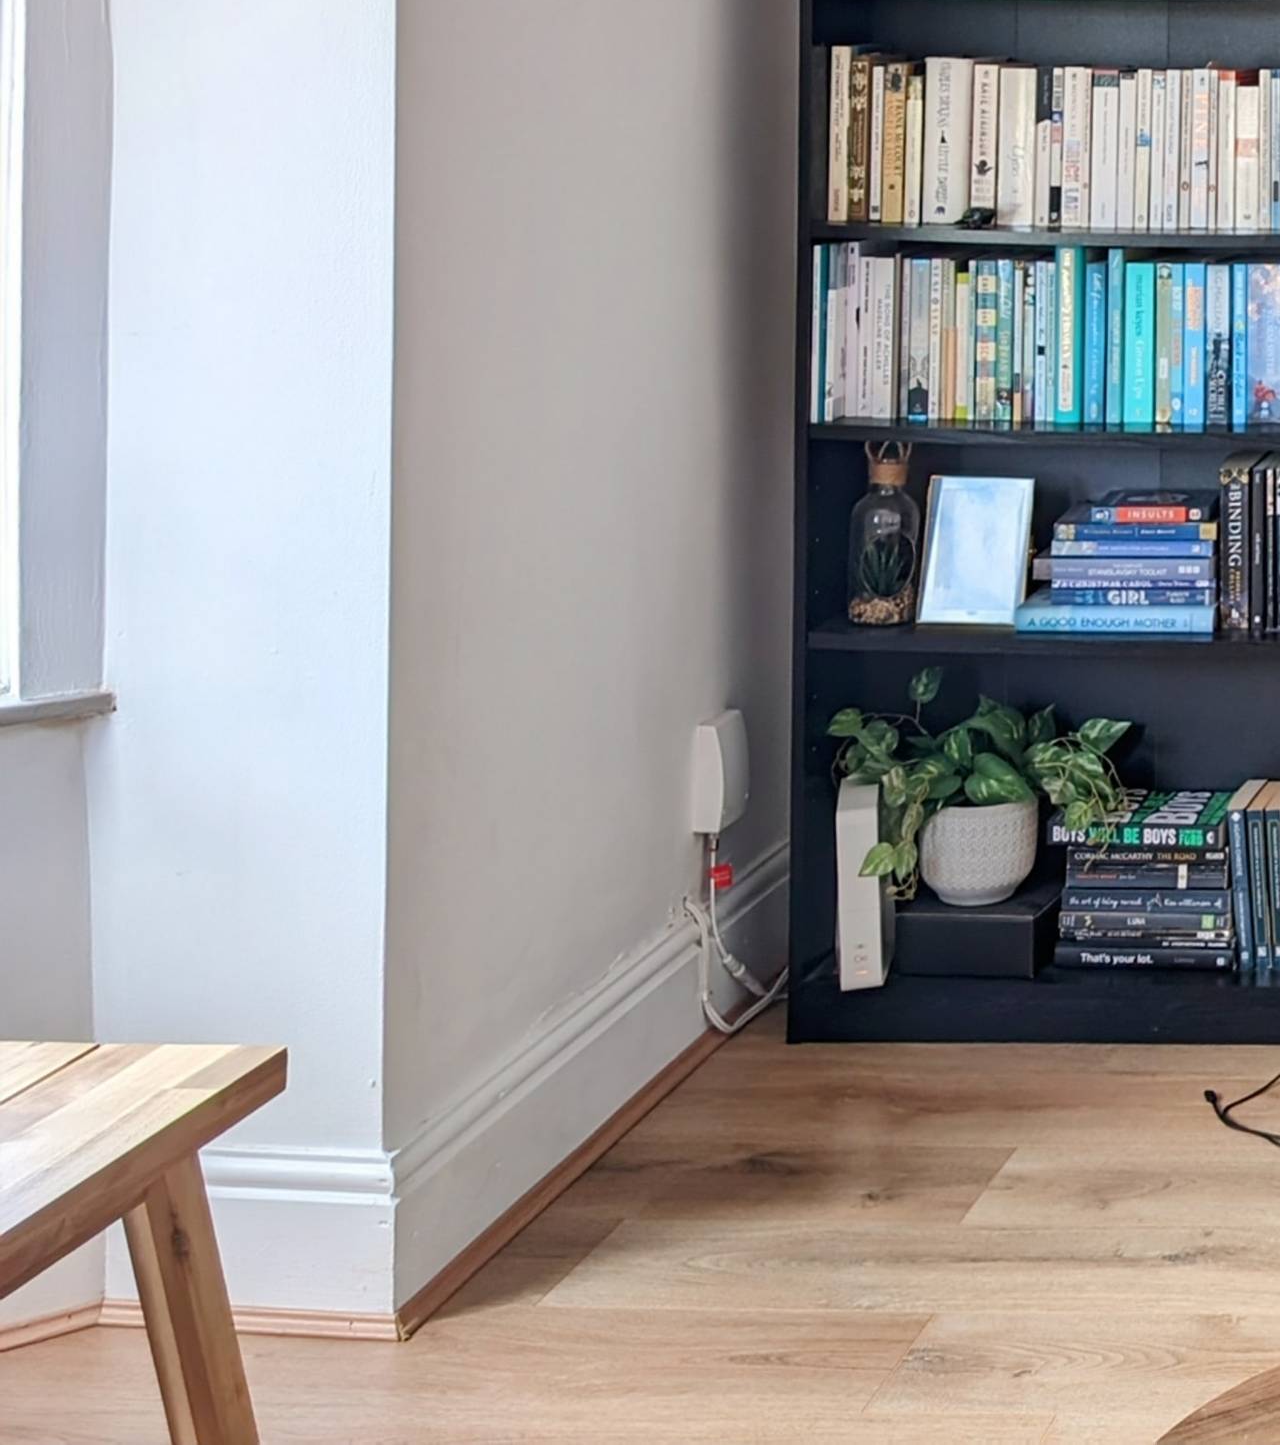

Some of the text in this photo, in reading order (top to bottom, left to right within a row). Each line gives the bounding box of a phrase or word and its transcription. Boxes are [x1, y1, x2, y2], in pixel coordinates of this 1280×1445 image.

[980, 82, 990, 156] KATE ATKINSON
[1136, 274, 1144, 307] marian
[1134, 310, 1145, 336] keyes
[882, 284, 891, 385] THE SONG OF ACHILLES
[1127, 509, 1175, 519] INSULTS
[1228, 490, 1242, 567] BINDING
[1139, 568, 1168, 576] TOOLKIT
[1068, 580, 1123, 588] CHRISTMAS
[1124, 580, 1153, 588] CAROL
[1107, 590, 1150, 605] GIRL
[1027, 617, 1176, 629] A GOOD ENOUGH MOTHER
[1053, 825, 1086, 842] BOYS
[1122, 826, 1140, 843] BE
[1143, 828, 1176, 844] BOYS
[1073, 852, 1109, 861] CORMAC
[1157, 852, 1173, 860] THE
[1174, 852, 1197, 861] ROAD
[1069, 897, 1079, 905] the
[1081, 897, 1092, 905] art
[1093, 897, 1100, 909] of
[1080, 952, 1155, 964] That's your lot.
